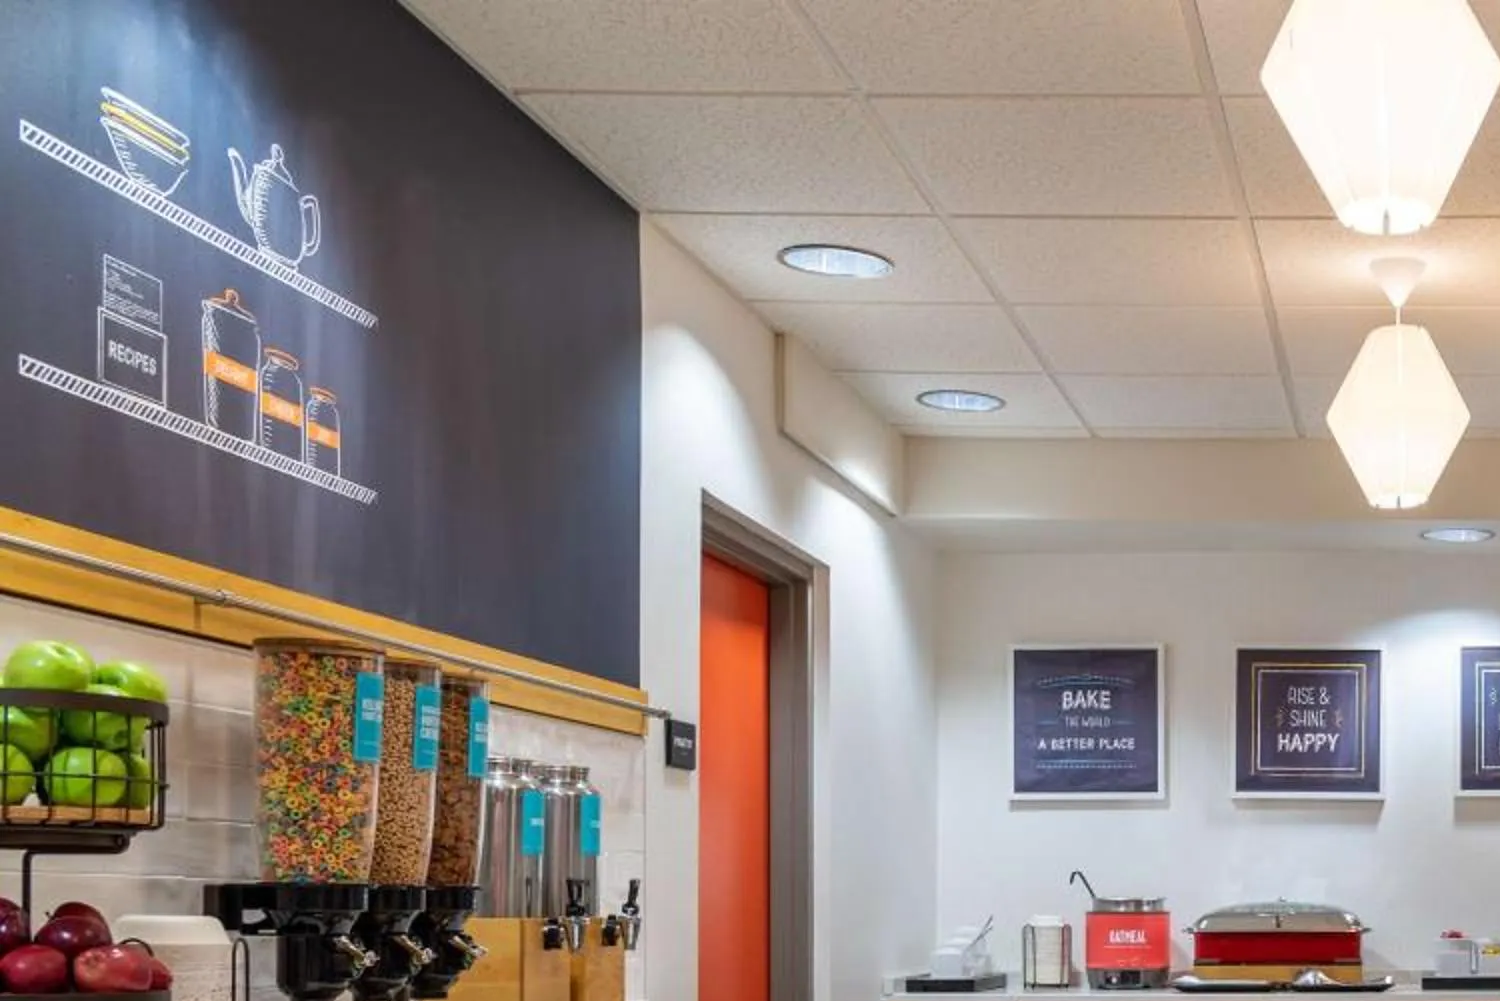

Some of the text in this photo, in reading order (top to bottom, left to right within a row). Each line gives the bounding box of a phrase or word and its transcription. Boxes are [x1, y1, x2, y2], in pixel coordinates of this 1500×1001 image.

[108, 340, 157, 376] RECIPES
[1062, 690, 1112, 710] BAKE
[1287, 686, 1331, 705] RISE &
[1289, 709, 1328, 728] SHINE
[1037, 738, 1136, 750] A BETTER PLACE
[1277, 733, 1340, 752] HAPPY
[1108, 929, 1147, 944] OATMEAL
